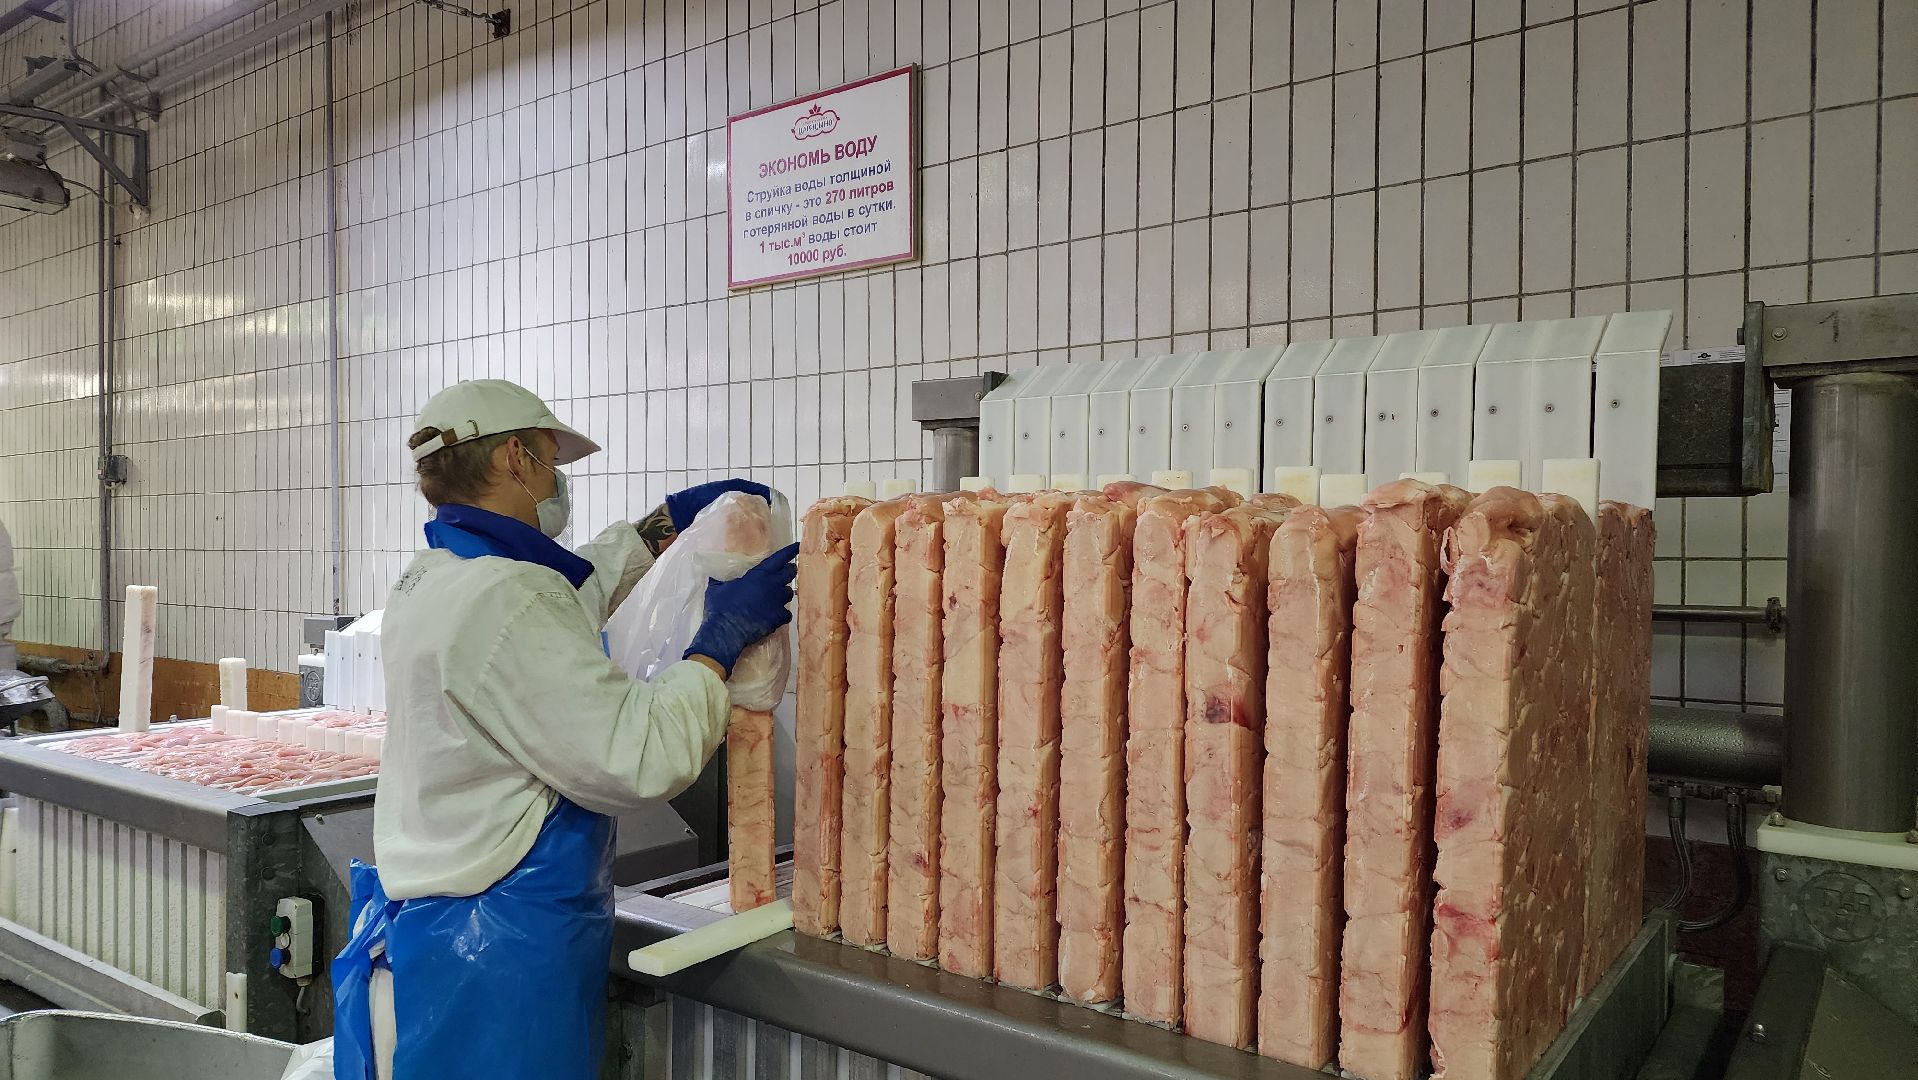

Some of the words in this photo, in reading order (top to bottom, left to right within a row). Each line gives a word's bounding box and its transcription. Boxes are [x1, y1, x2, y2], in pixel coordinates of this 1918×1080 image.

[759, 149, 831, 178] ЭКОНОМЬ
[834, 135, 878, 161] ВОДУ
[747, 184, 792, 204] Струйка
[794, 177, 826, 192] воды
[829, 158, 891, 185] толщиной
[745, 211, 752, 222] в
[754, 202, 793, 219] спичку
[803, 196, 822, 209] это
[825, 188, 846, 205] 270
[848, 180, 894, 200] литров
[812, 211, 844, 226] воды
[847, 208, 855, 219] в
[858, 199, 896, 218] сутки.
[759, 240, 765, 254] 1
[808, 229, 840, 244] воды
[843, 222, 878, 238] стоит
[787, 248, 819, 266] 10000
[822, 243, 847, 263] руб.
